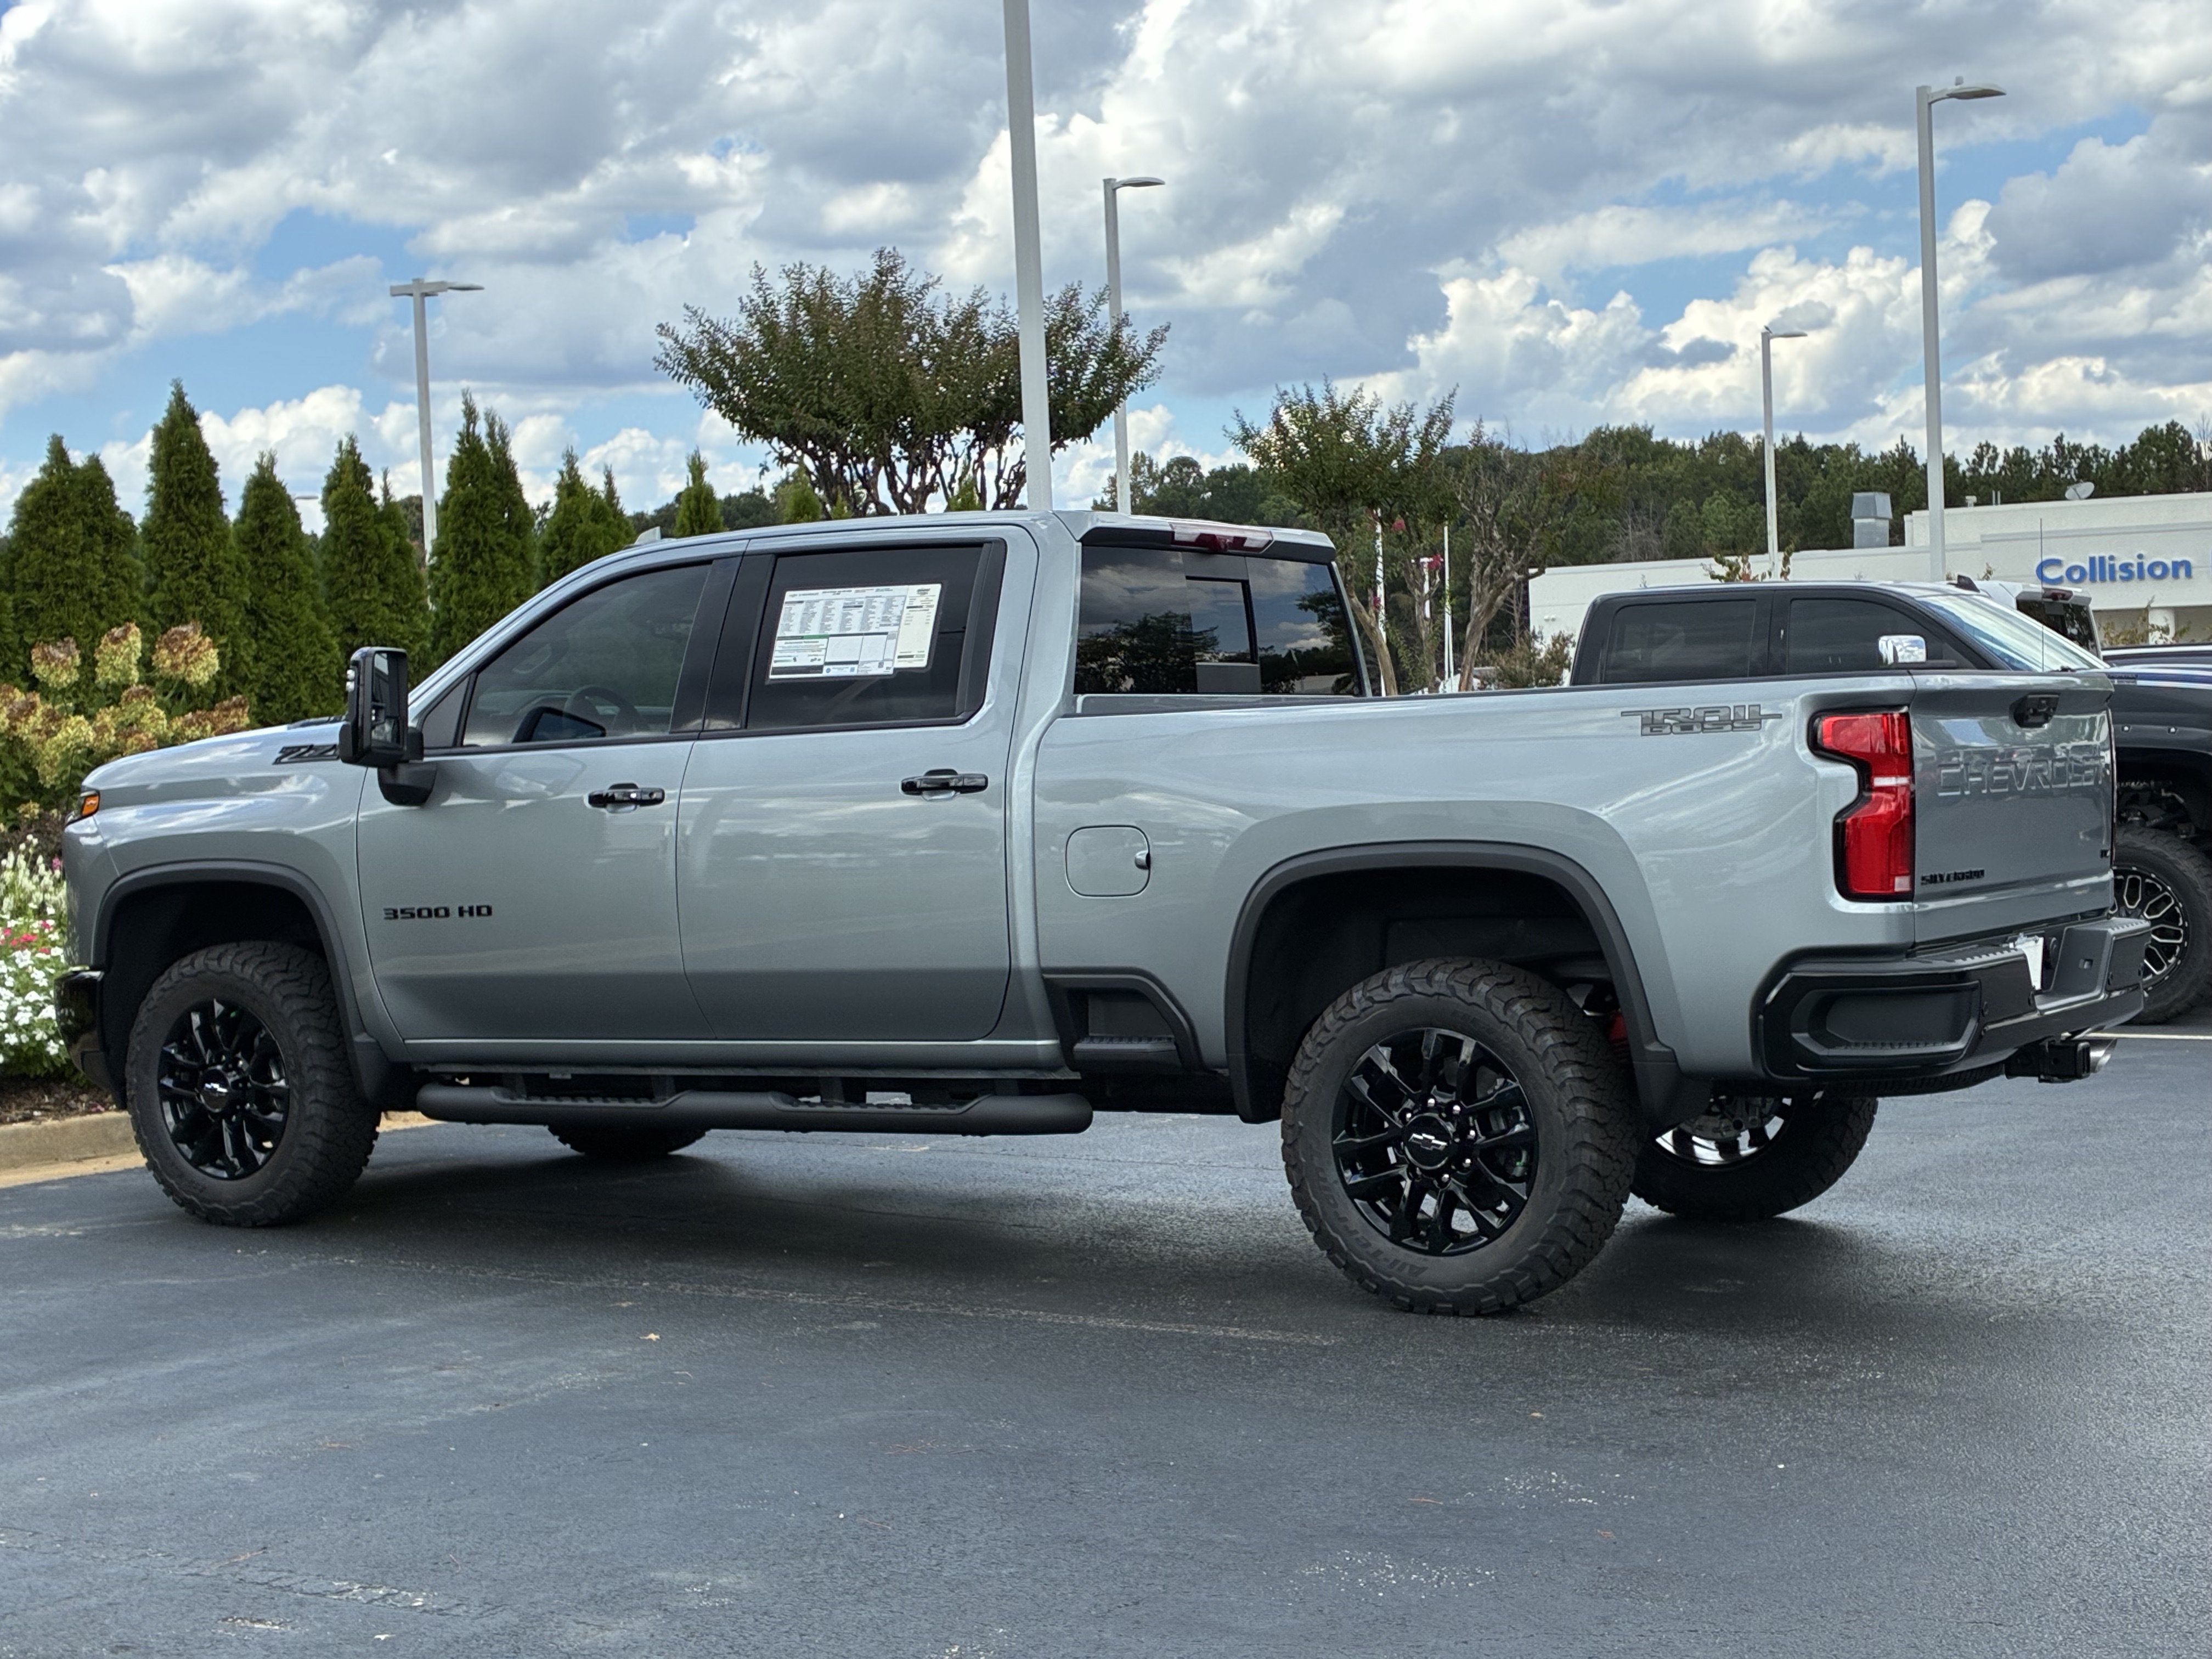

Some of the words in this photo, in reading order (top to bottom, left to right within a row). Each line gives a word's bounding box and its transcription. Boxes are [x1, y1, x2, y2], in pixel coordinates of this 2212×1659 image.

[2035, 553, 2192, 585] Collision
[1620, 704, 1782, 726] TRAIL
[1640, 719, 1762, 736] BOSS
[383, 906, 450, 920] 3500
[458, 904, 493, 918] HD
